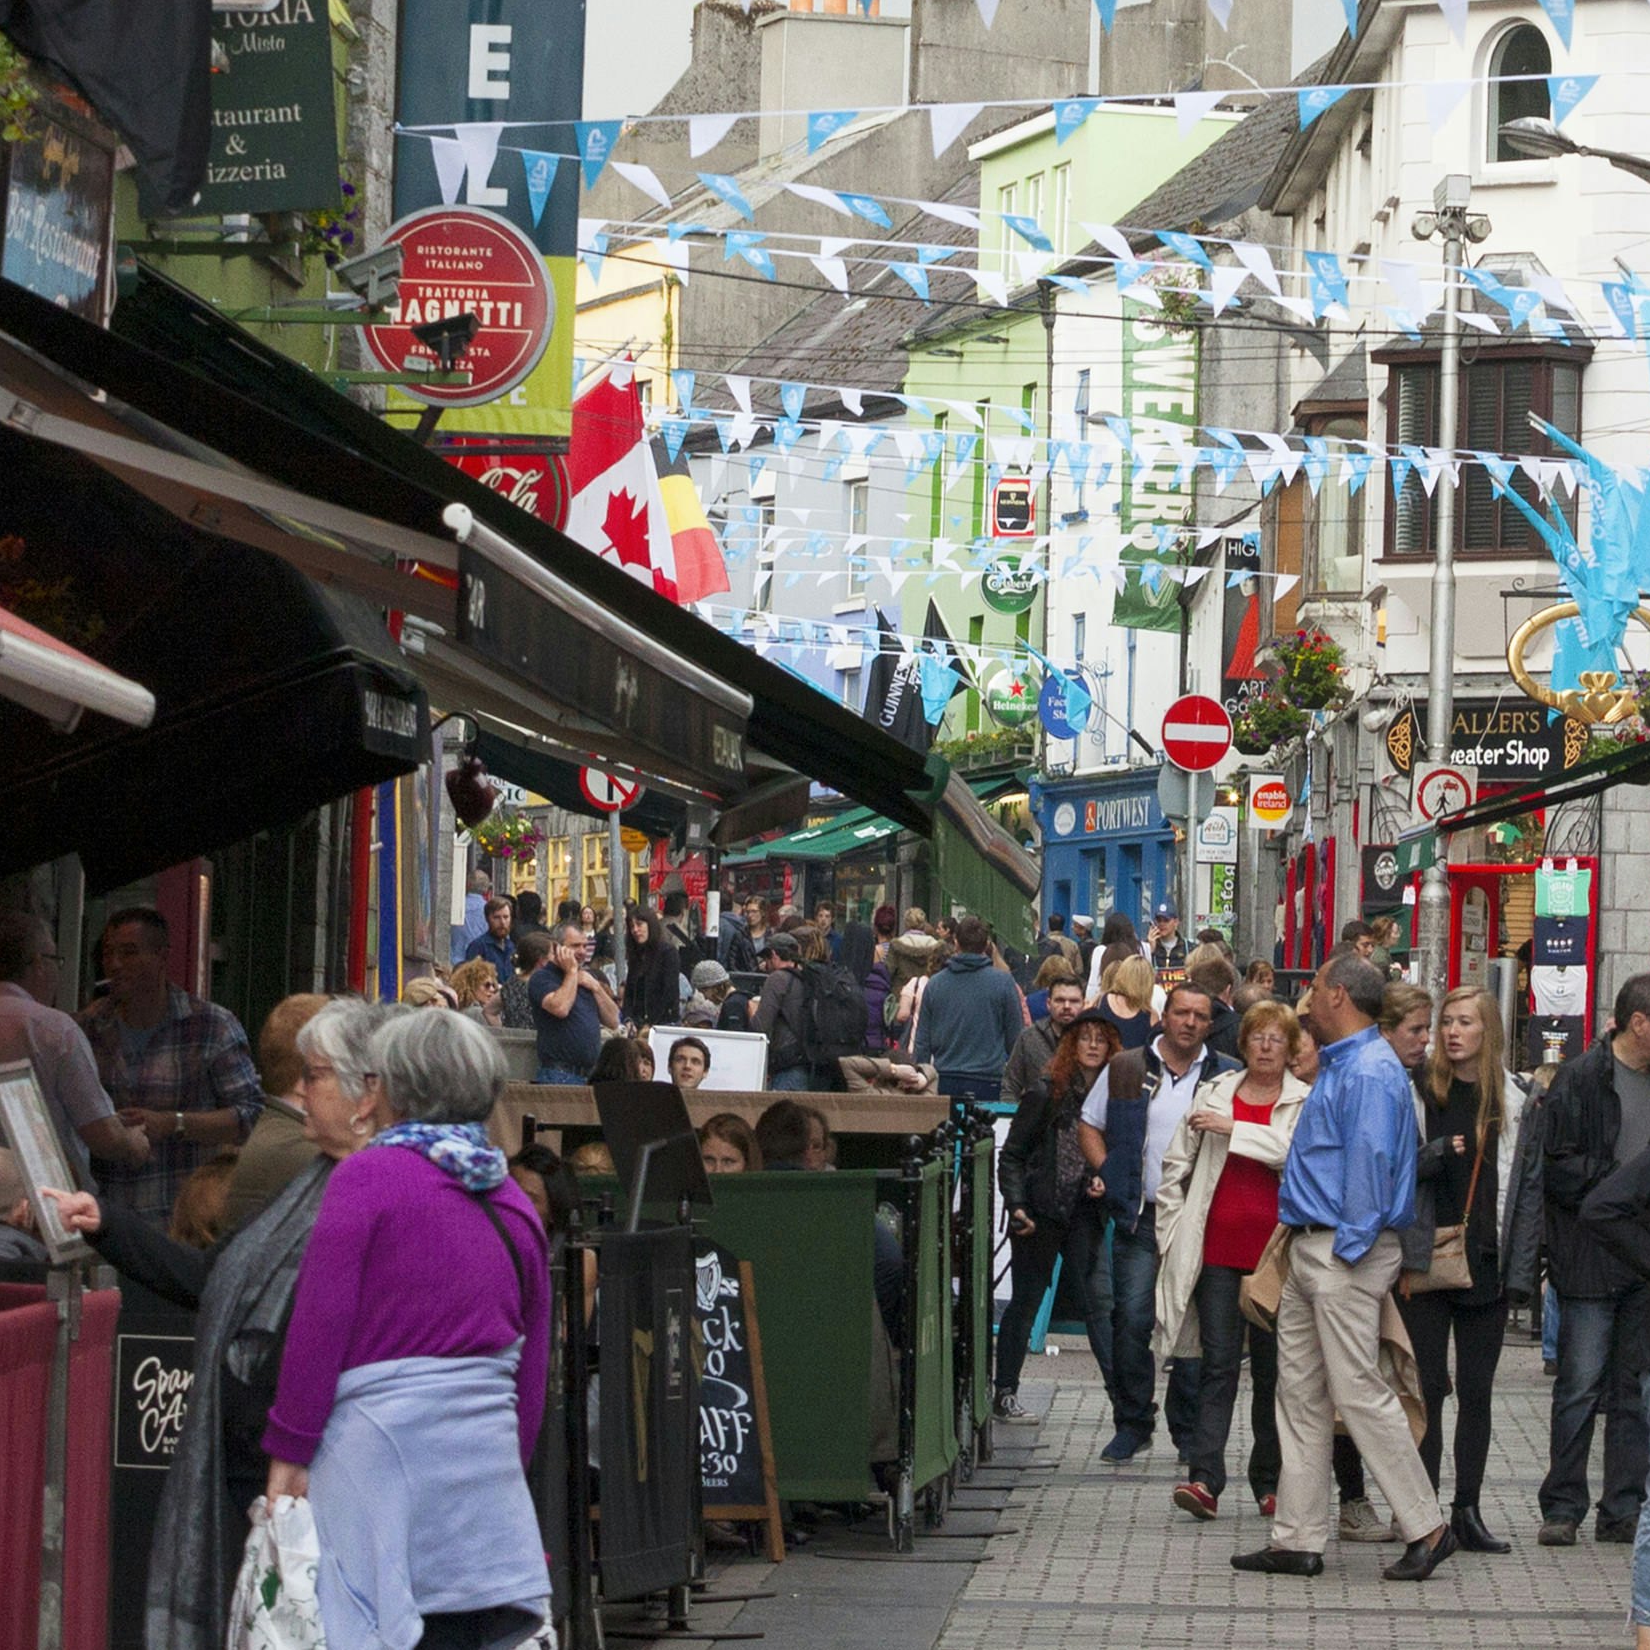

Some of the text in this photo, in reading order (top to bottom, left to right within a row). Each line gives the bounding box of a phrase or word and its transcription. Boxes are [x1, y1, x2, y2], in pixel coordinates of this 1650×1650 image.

[211, 102, 303, 128] taurant
[224, 133, 249, 156] &
[207, 158, 287, 186] izzeria
[416, 245, 493, 258] RISTORANTE
[425, 259, 484, 271] ITALIANO
[417, 286, 489, 300] TRATTORIA
[878, 664, 911, 728] GUINNES
[992, 700, 1038, 712] Heineken
[1451, 711, 1541, 735] ALLER'S
[1450, 739, 1550, 771] eater Shop
[1256, 790, 1287, 800] enable
[1256, 799, 1287, 809] ireland
[1096, 796, 1150, 831] PORTWEST
[702, 1305, 744, 1352] ck
